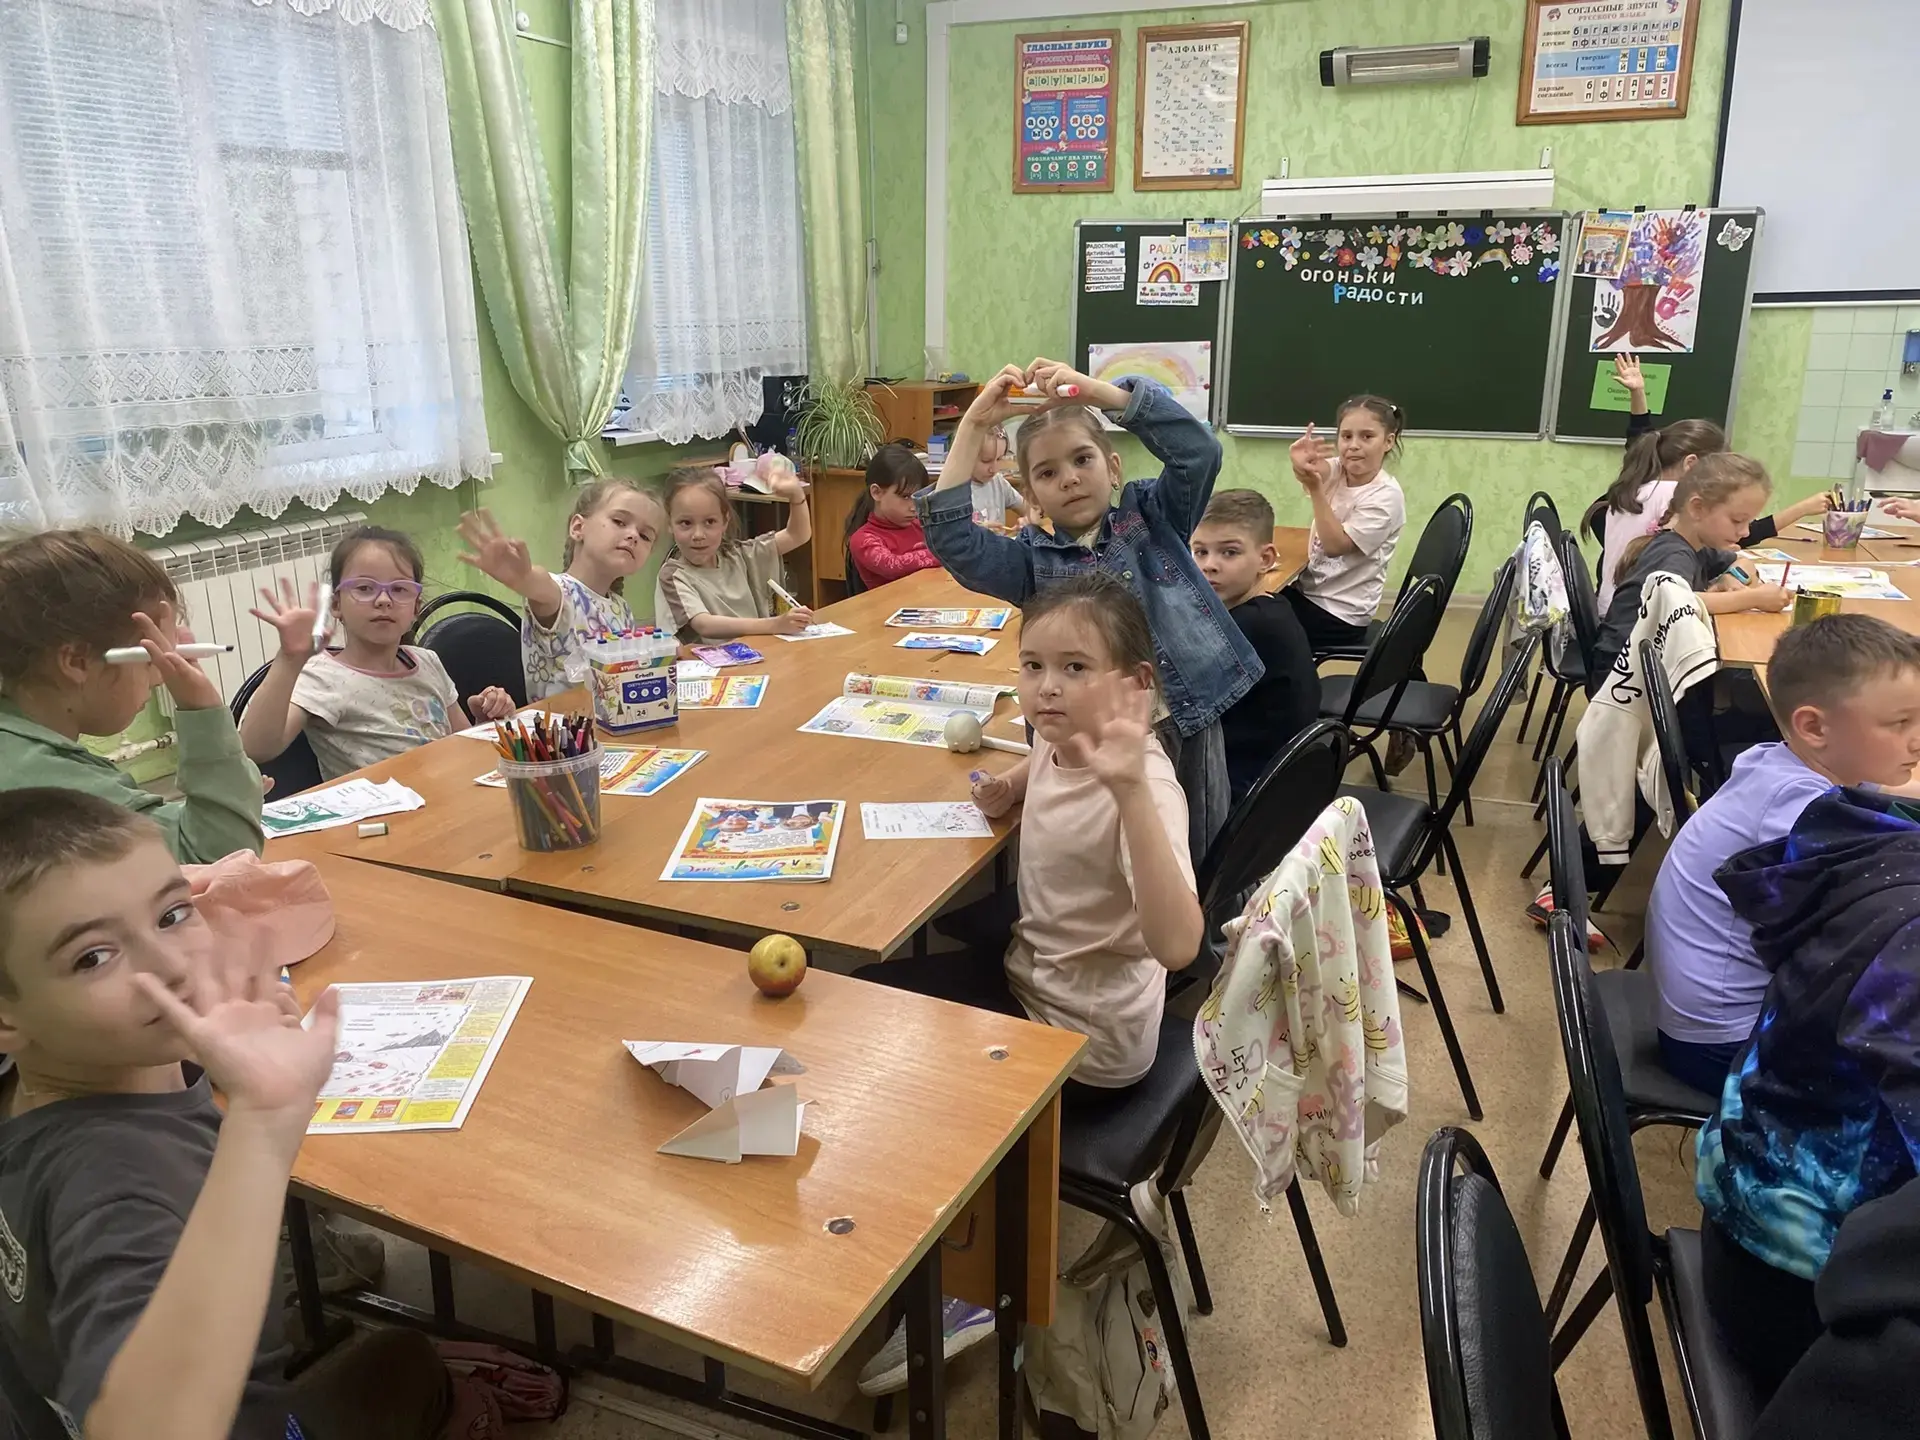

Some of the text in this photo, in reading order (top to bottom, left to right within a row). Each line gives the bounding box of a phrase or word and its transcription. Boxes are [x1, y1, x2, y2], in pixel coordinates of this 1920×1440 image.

[1567, 2, 1658, 14] СОГЛАСНЫЕ ЗВУКИ
[1027, 43, 1072, 51] ГЛАСНЫЕ
[1168, 44, 1218, 54] АЛФАВИТ
[1150, 244, 1186, 254] РАДУГ
[1300, 268, 1395, 284] огоньки
[1212, 1064, 1231, 1096] FLY
